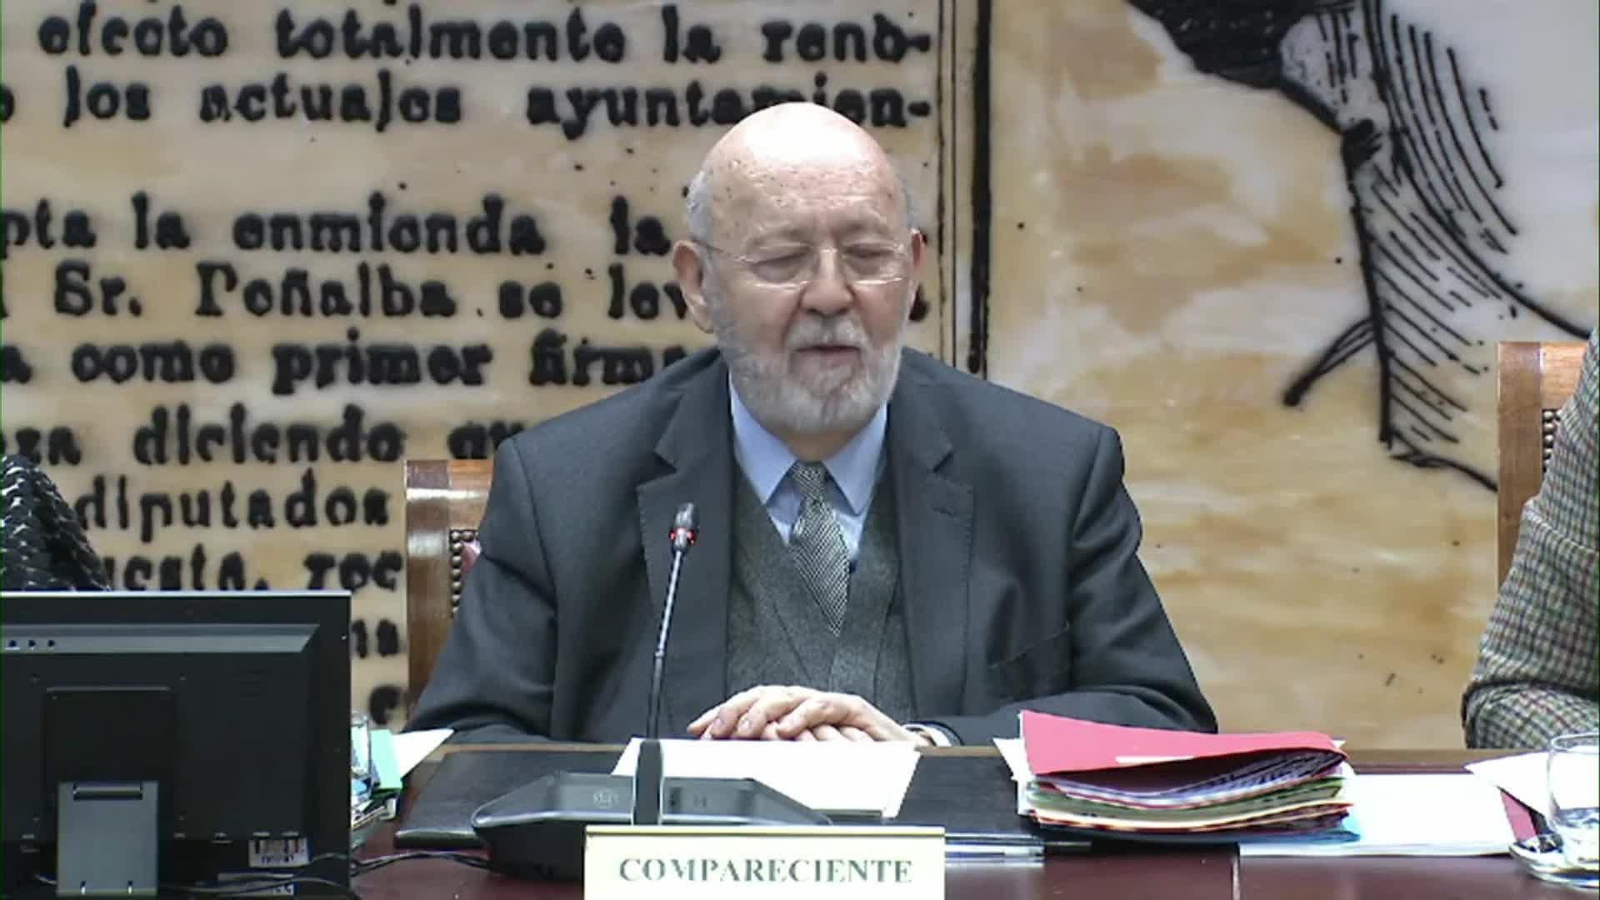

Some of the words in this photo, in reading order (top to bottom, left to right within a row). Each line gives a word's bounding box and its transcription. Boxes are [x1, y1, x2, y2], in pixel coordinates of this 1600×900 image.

[274, 3, 626, 65] totalmente
[661, 4, 723, 65] la
[63, 66, 152, 129] los
[199, 68, 462, 134] actuales
[131, 192, 192, 251] la
[232, 191, 548, 257] enmienda
[53, 260, 143, 318] Sr.
[70, 339, 236, 385] como
[271, 326, 494, 396] primer
[132, 402, 407, 467] diciendo
[618, 857, 914, 884] COMPARECIENTE
